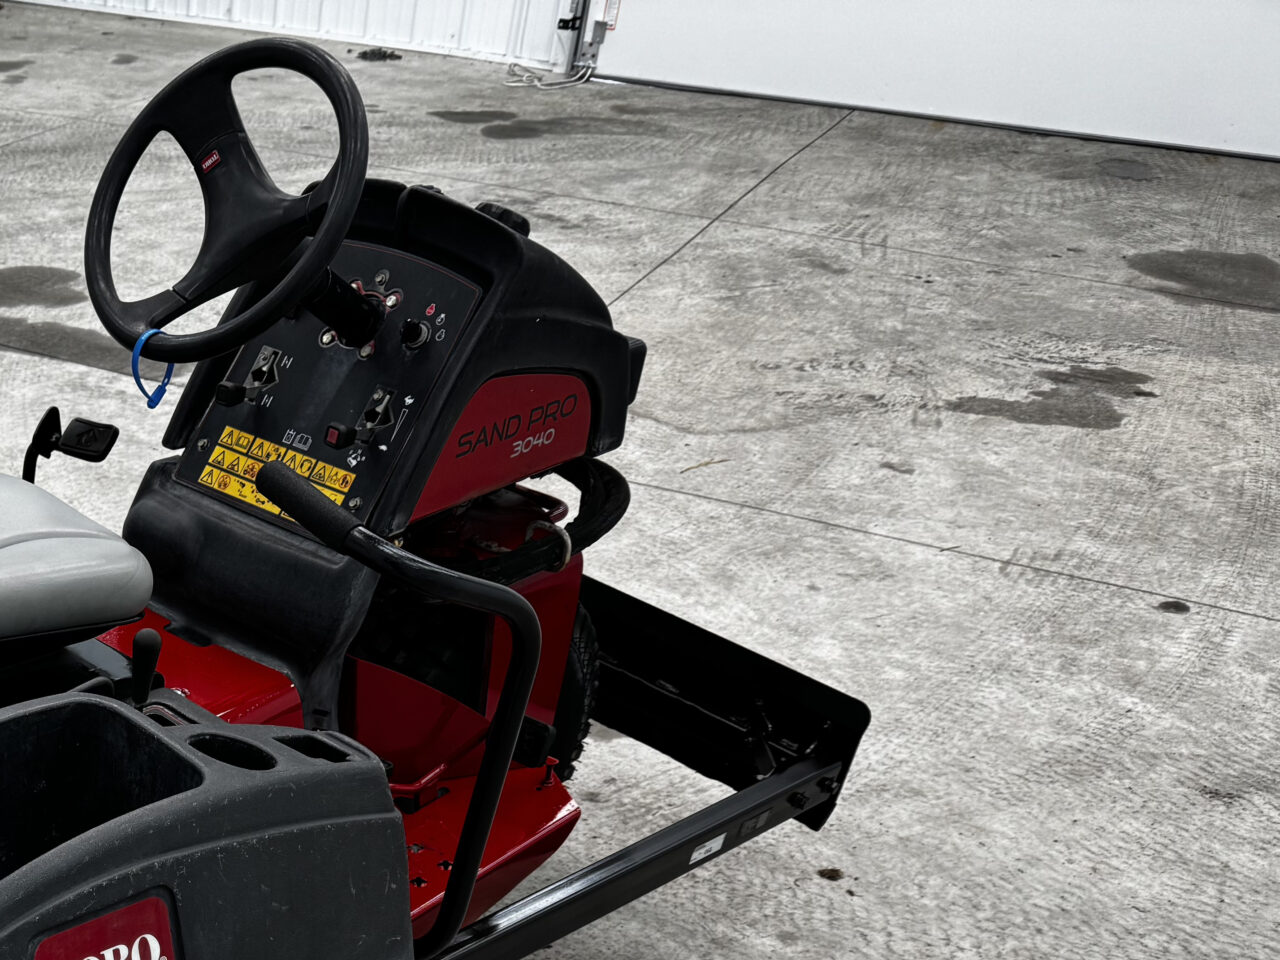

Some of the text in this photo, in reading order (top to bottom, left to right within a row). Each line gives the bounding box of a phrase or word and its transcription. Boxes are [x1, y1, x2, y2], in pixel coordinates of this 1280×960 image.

[456, 394, 578, 458] SAND PRO
[510, 428, 555, 458] 3040
